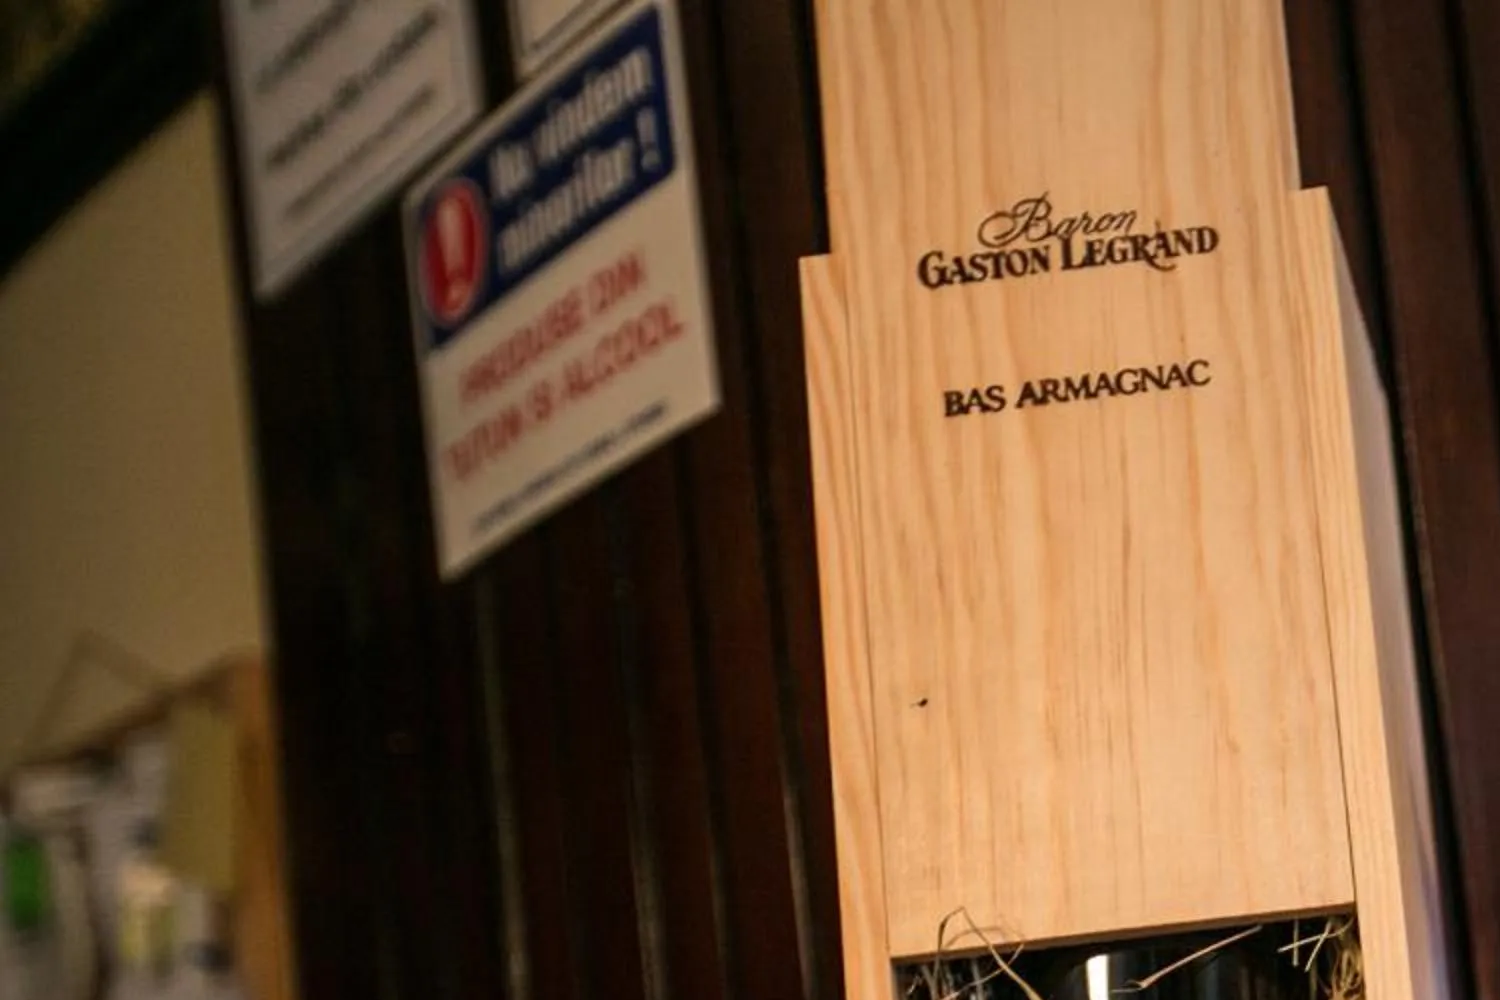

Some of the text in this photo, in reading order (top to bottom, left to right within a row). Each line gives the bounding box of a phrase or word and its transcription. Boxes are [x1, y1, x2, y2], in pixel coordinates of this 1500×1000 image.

[977, 192, 1137, 249] Baron
[943, 359, 1211, 417] BAS ARMAGNAC
